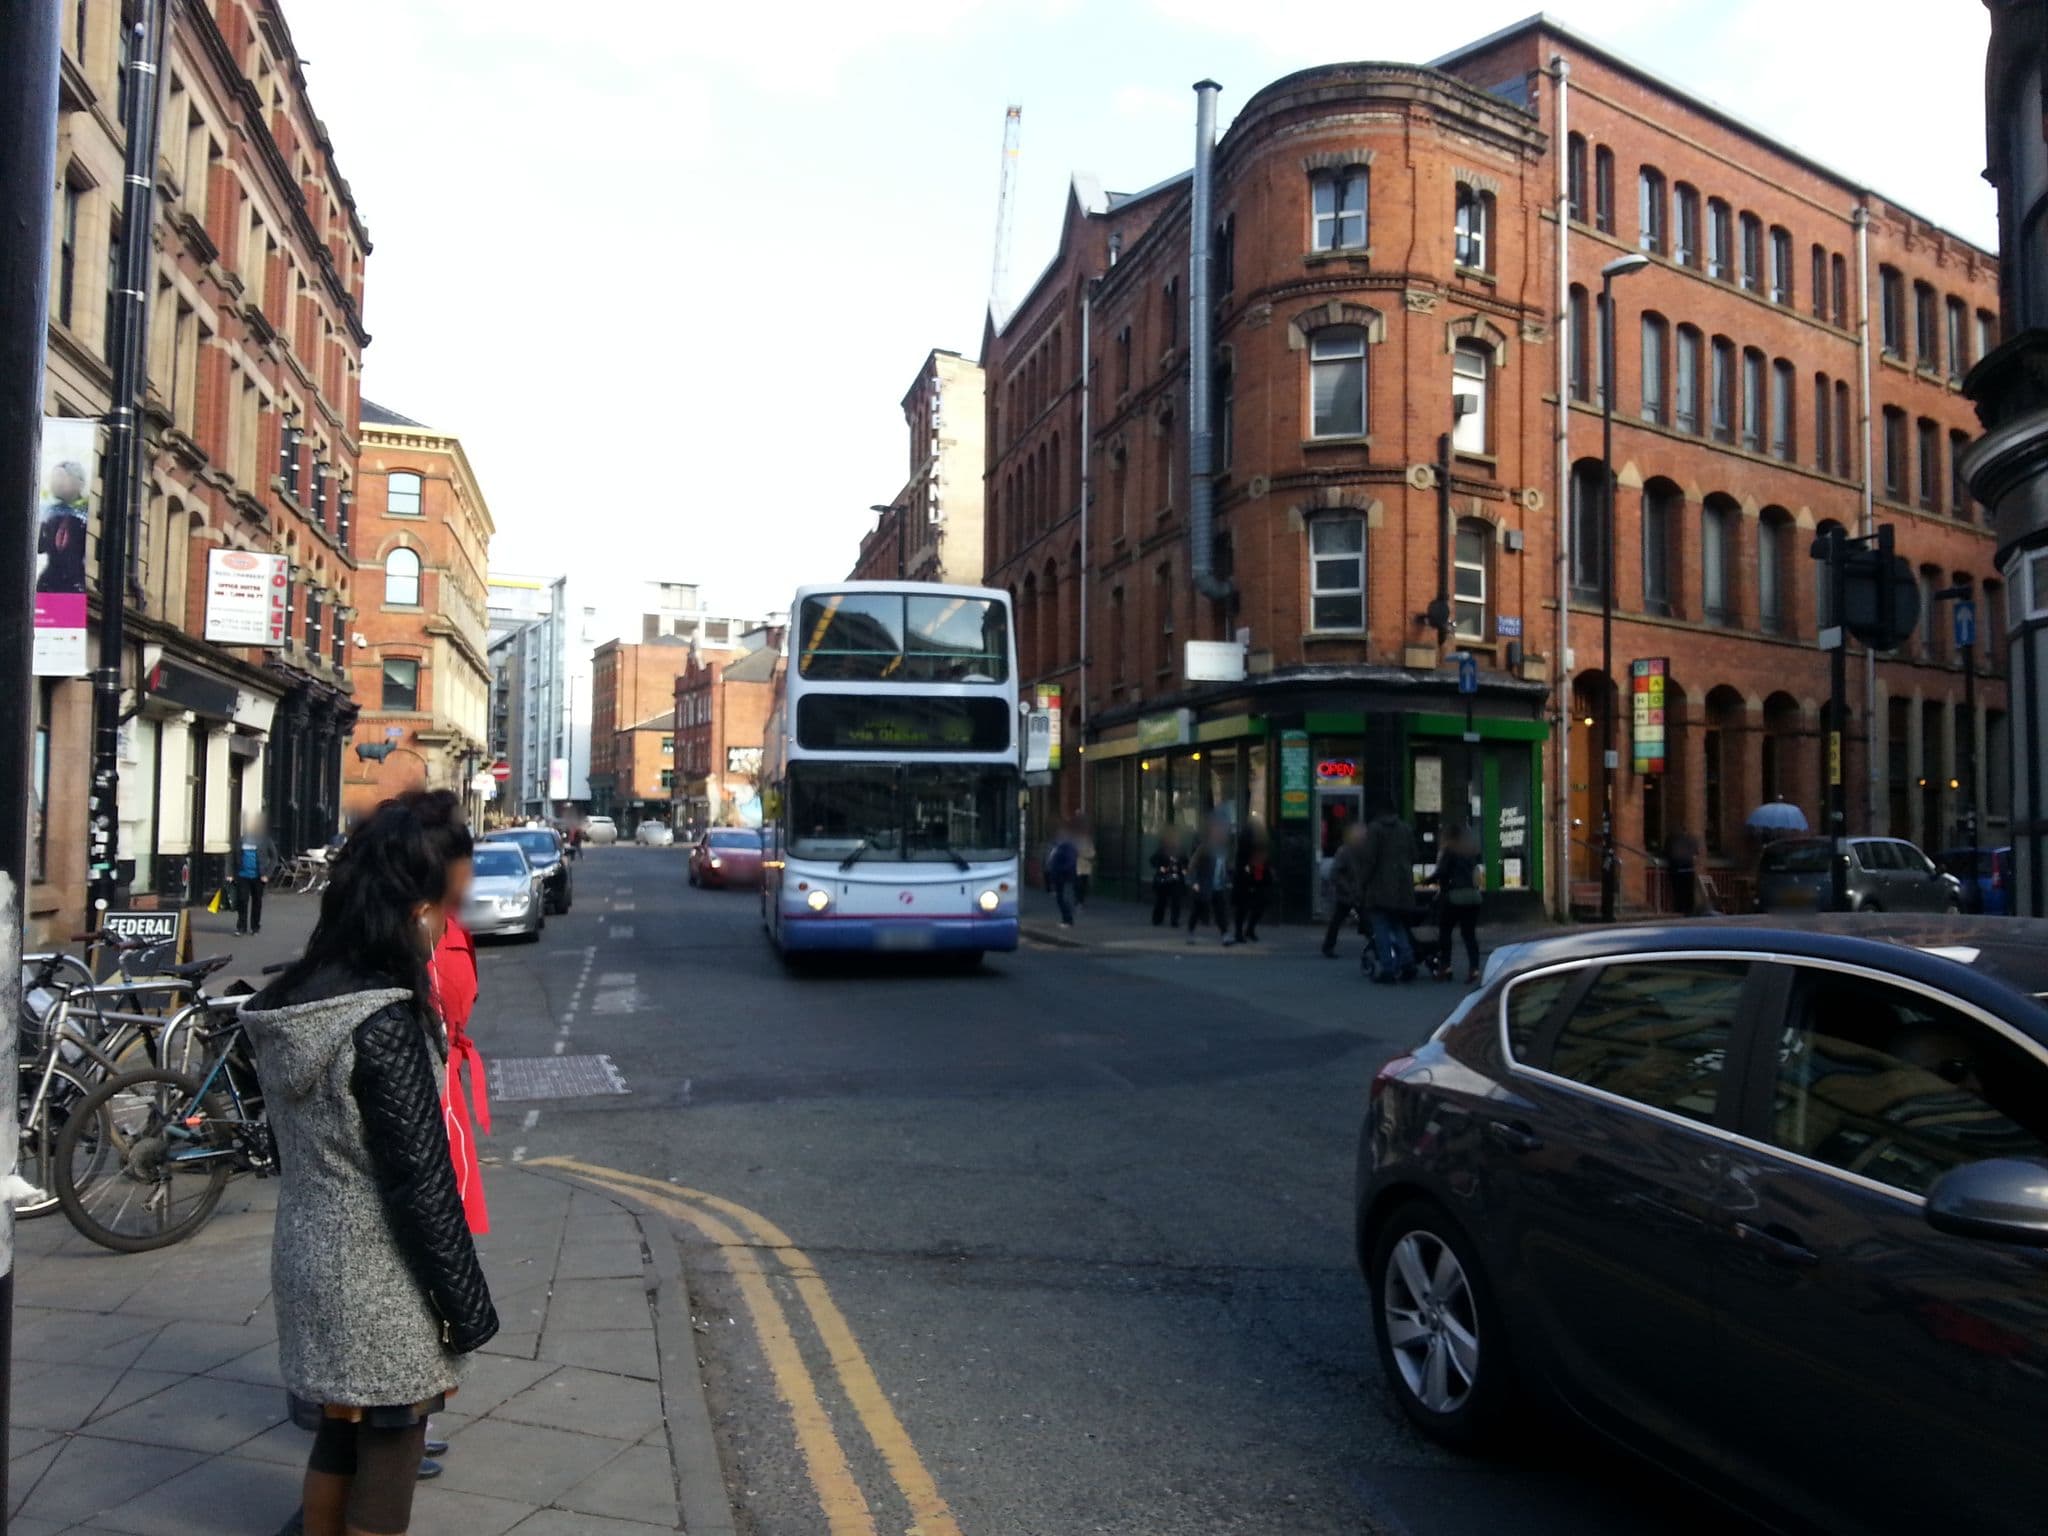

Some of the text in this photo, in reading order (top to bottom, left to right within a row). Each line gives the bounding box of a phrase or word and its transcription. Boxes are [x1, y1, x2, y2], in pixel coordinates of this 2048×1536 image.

[270, 559, 287, 640] TO LET
[1317, 761, 1356, 778] OPEN
[108, 918, 173, 936] FEDERAL
